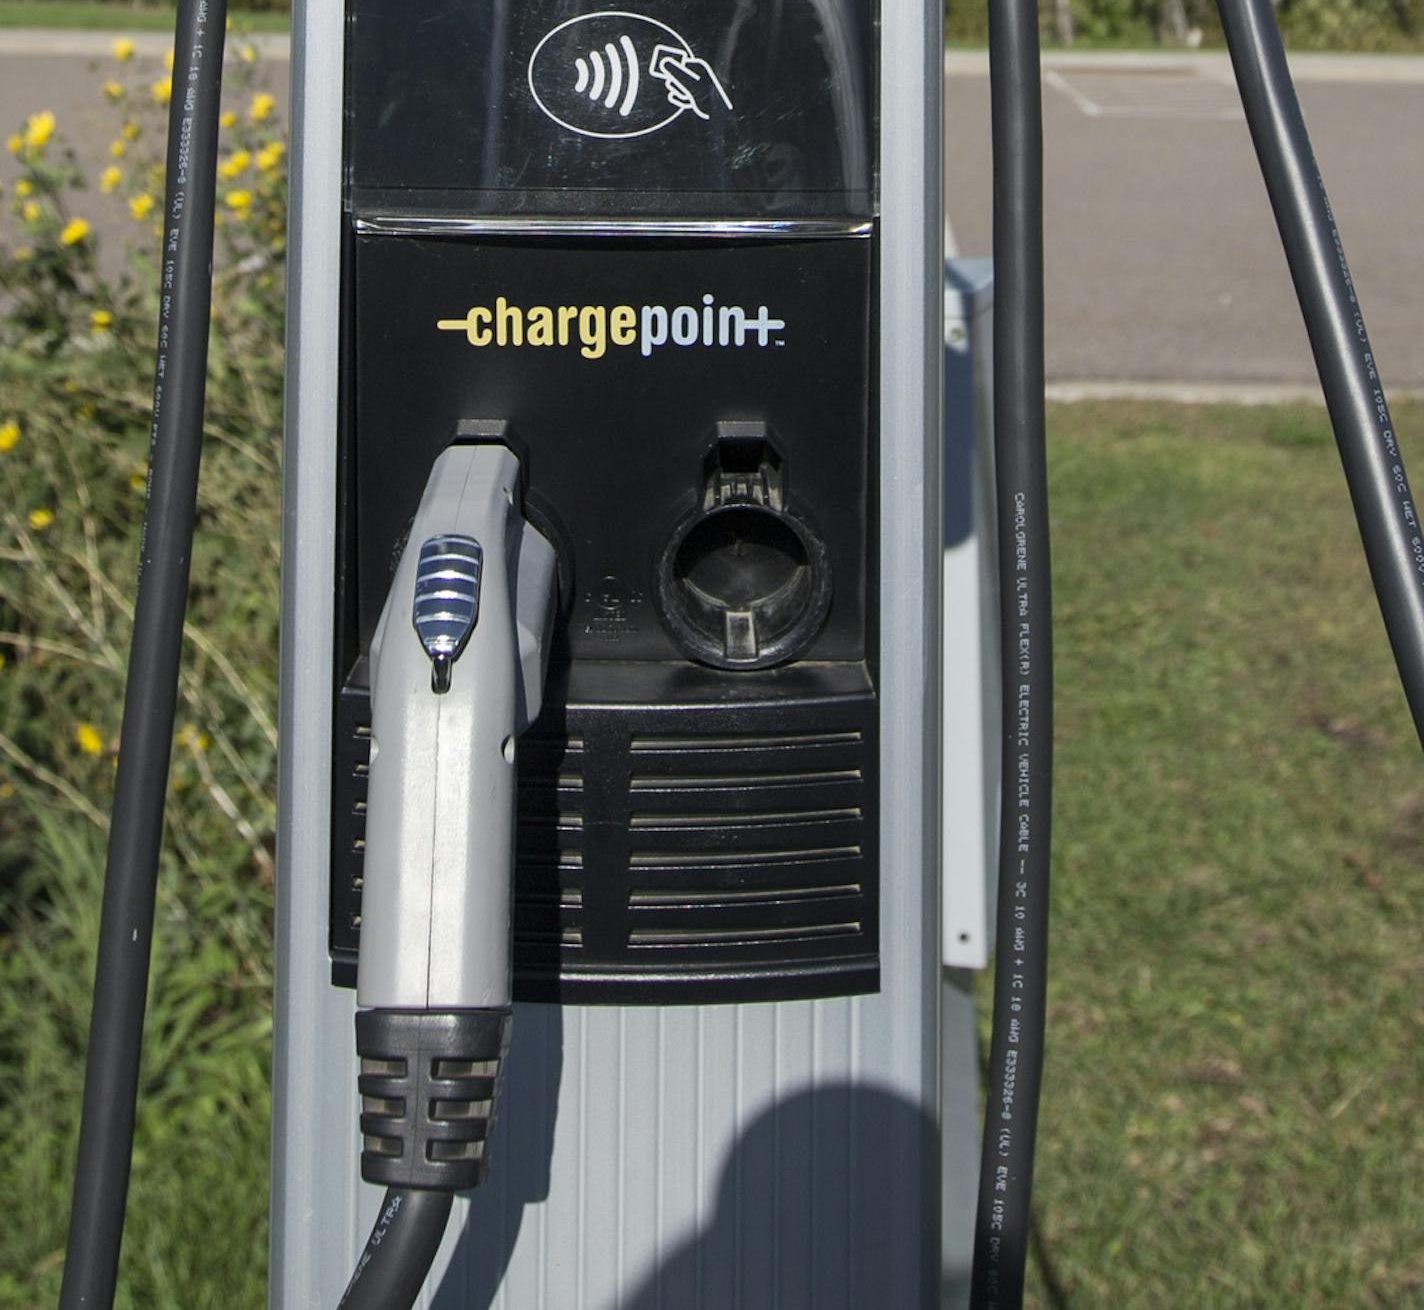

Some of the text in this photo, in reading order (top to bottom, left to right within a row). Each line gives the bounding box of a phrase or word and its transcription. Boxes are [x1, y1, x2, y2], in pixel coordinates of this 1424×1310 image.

[1015, 576, 1030, 617] ULTRA
[1016, 683, 1031, 747] ELECTRIC
[1017, 752, 1031, 808] VEHICLE
[1016, 813, 1031, 853] CABLE
